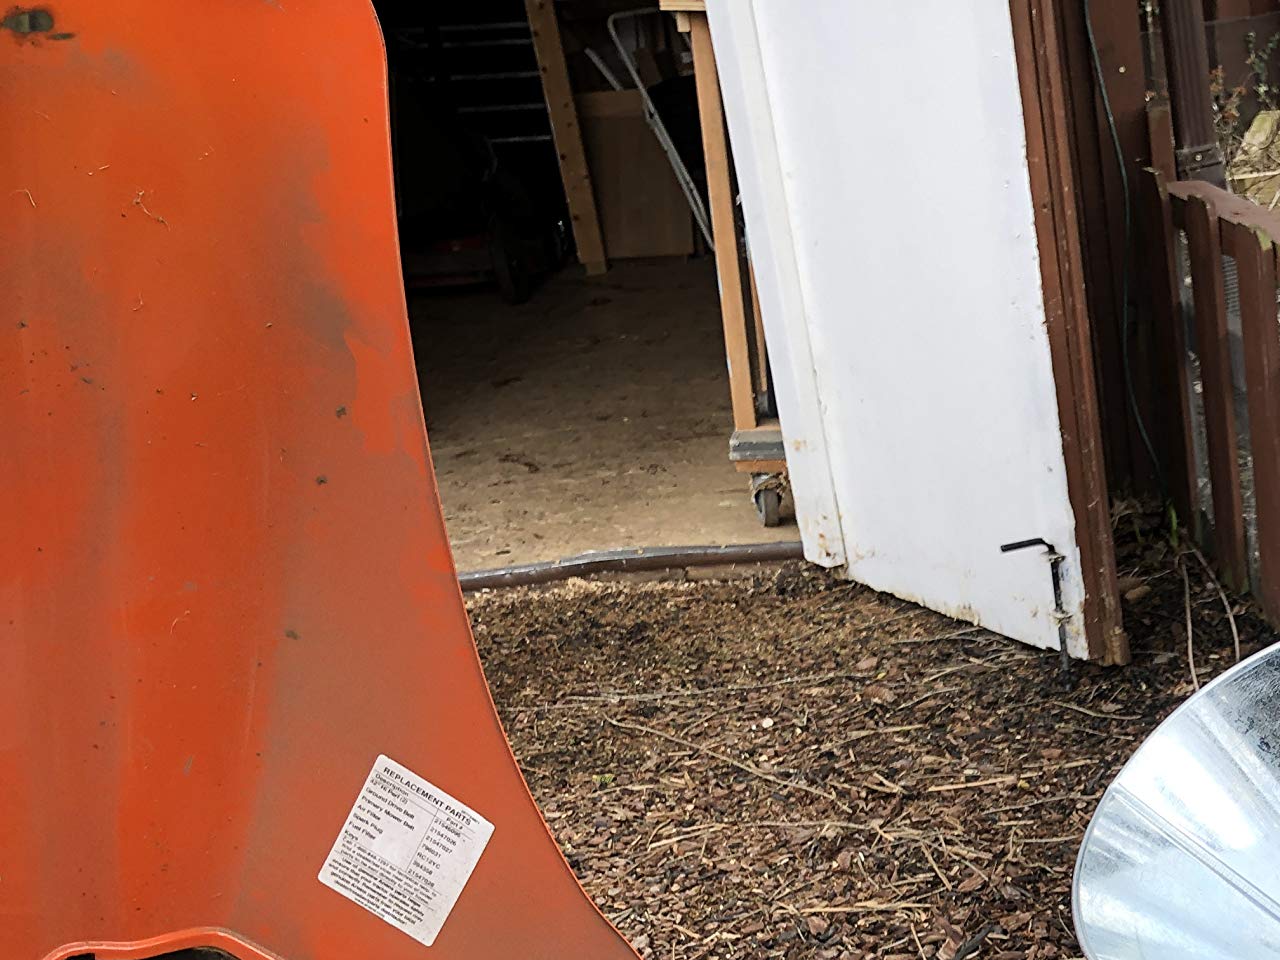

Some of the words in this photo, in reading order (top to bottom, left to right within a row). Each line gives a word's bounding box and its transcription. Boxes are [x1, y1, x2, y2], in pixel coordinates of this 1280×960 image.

[374, 773, 409, 797] Description
[382, 766, 444, 808] REPLACEMENT
[443, 804, 472, 825] PARTS
[384, 809, 402, 823] Mower
[403, 820, 414, 830] Belt
[402, 809, 414, 820] Belt
[343, 829, 358, 841] Keys
[369, 822, 383, 834] Plug
